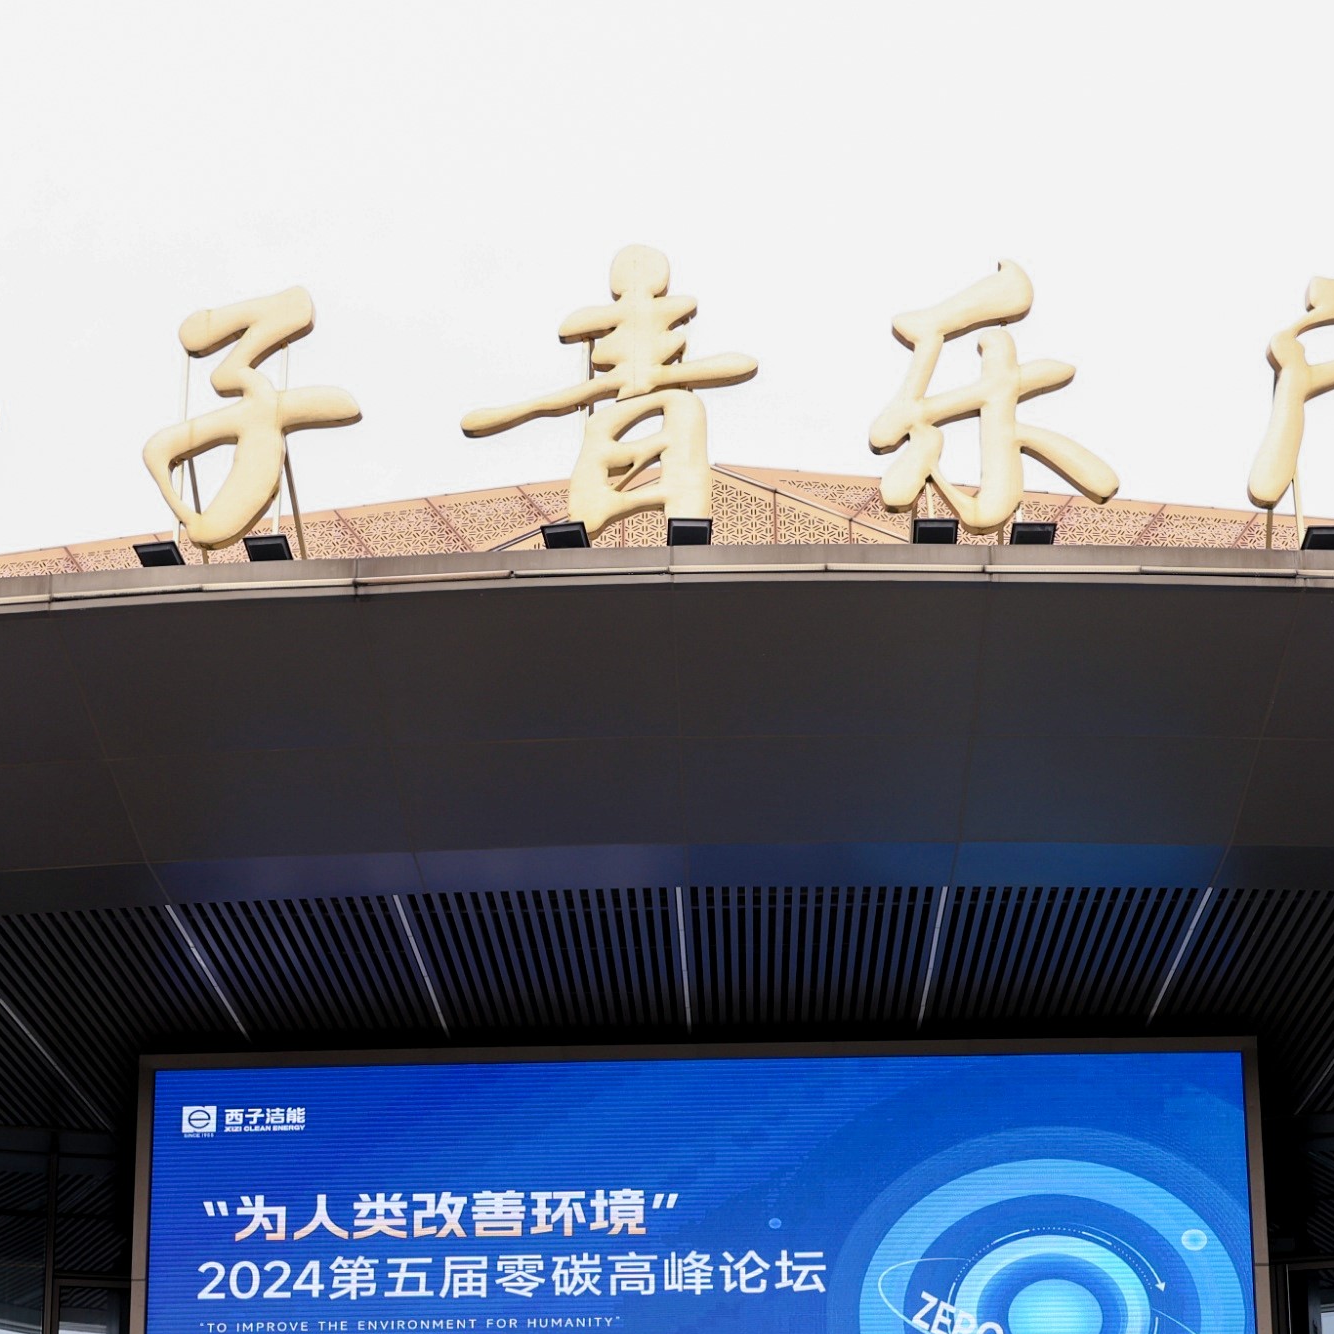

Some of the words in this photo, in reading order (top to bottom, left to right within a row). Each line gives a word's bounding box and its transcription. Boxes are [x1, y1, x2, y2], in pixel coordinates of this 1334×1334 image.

[224, 1107, 306, 1125] 西子洁能
[203, 1188, 678, 1241] “为人类改善环境”
[197, 1249, 827, 1300] 2024第五届零碳高峰论坛
[236, 1321, 309, 1332] IMPROVE
[318, 1320, 348, 1331] THE
[357, 1318, 477, 1331] ENVIRONMENT
[486, 1318, 518, 1328] FOR
